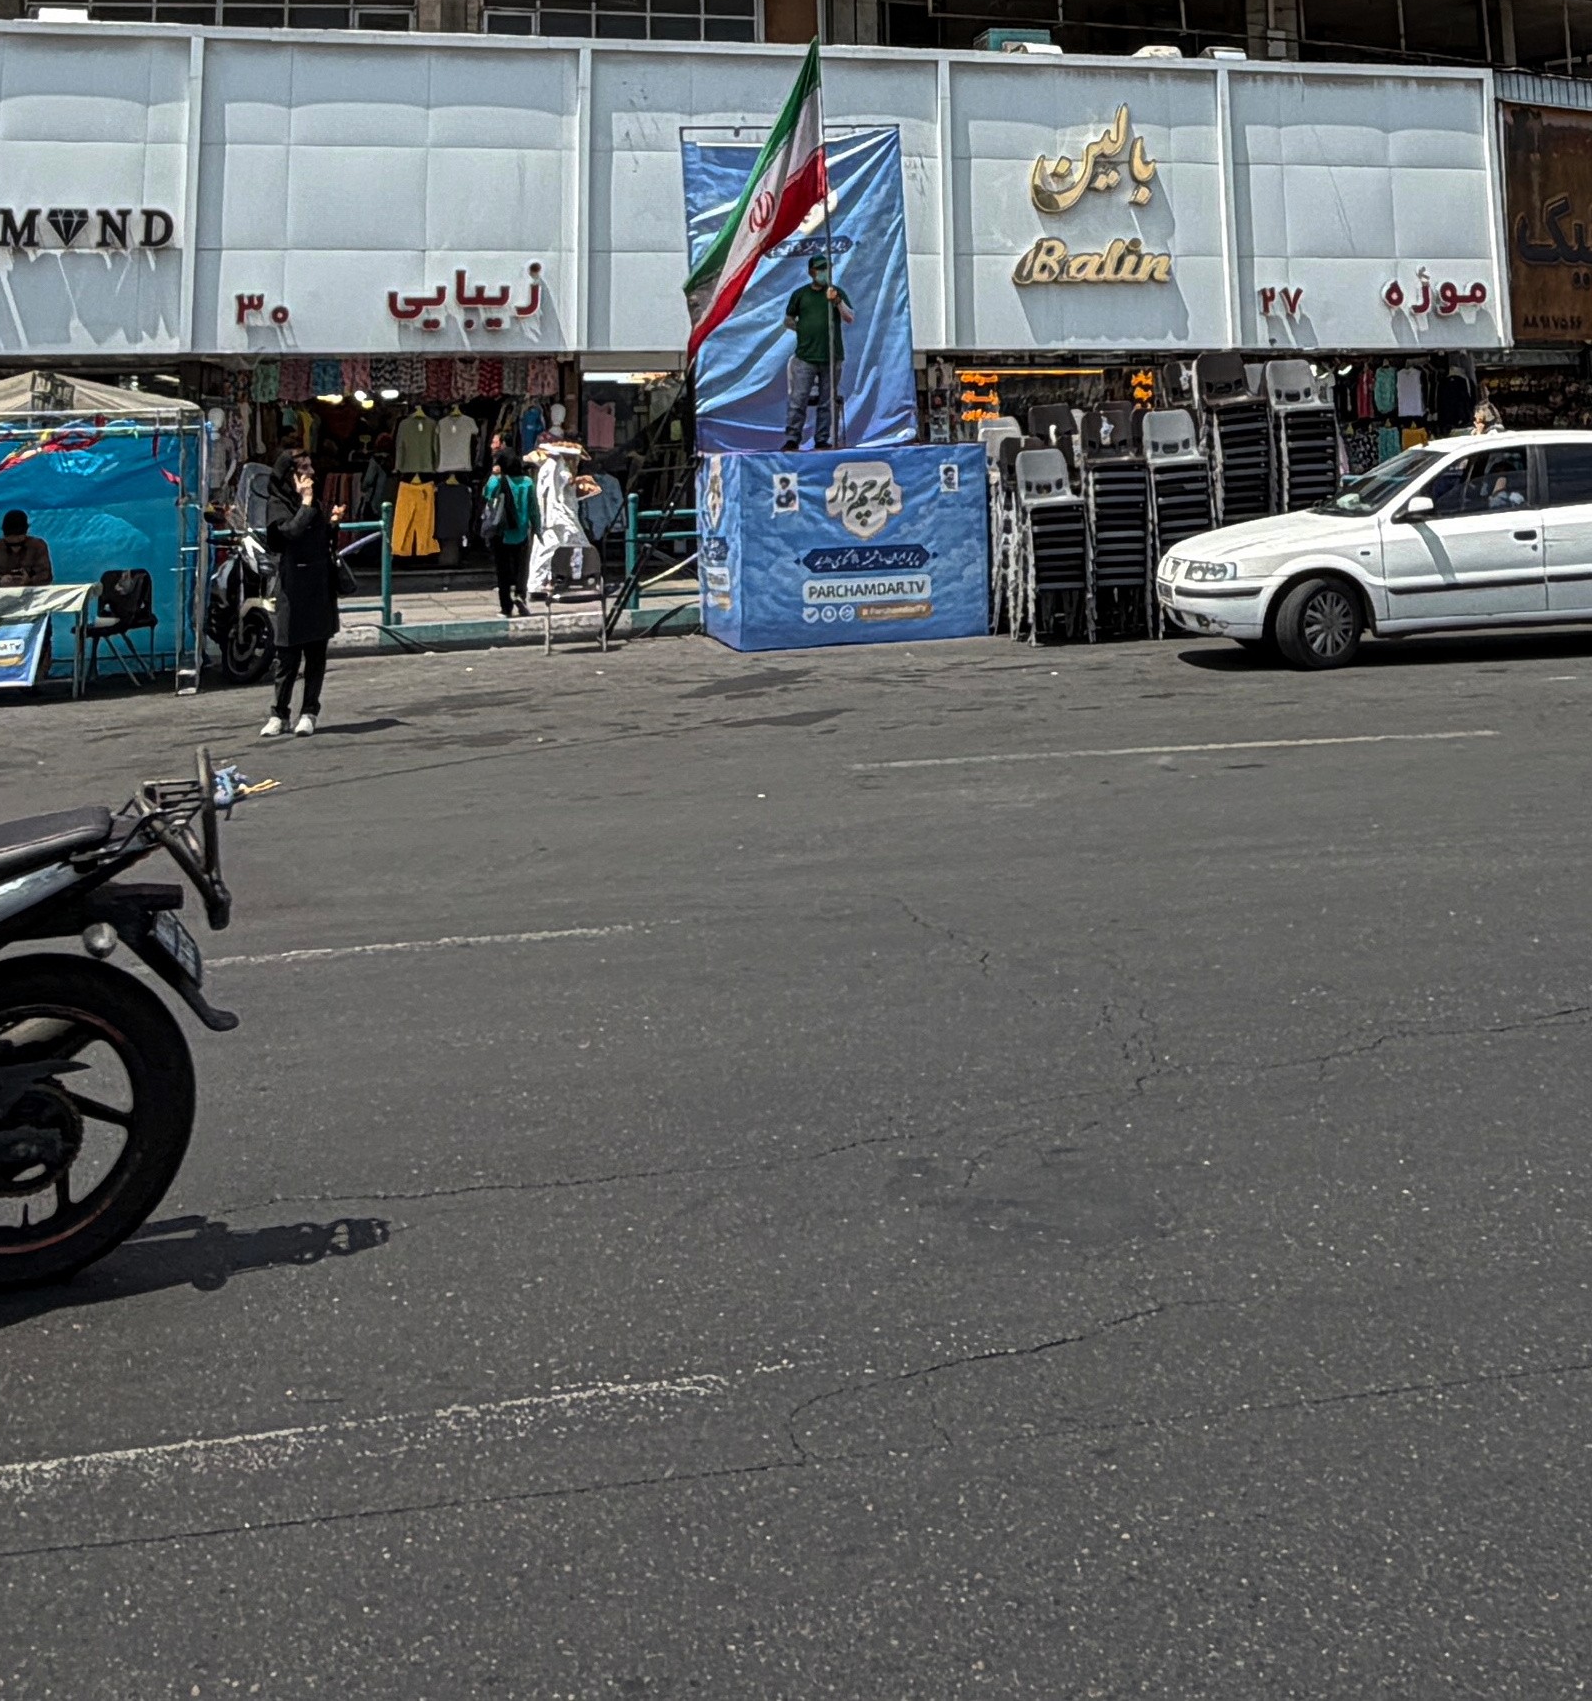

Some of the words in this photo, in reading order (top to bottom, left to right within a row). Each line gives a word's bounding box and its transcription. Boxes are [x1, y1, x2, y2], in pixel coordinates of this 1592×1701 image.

[1029, 102, 1157, 213] بالین
[1010, 236, 1172, 285] Balin
[386, 261, 544, 332] زیبایی
[808, 581, 926, 598] PARCHAMDAR.TV
